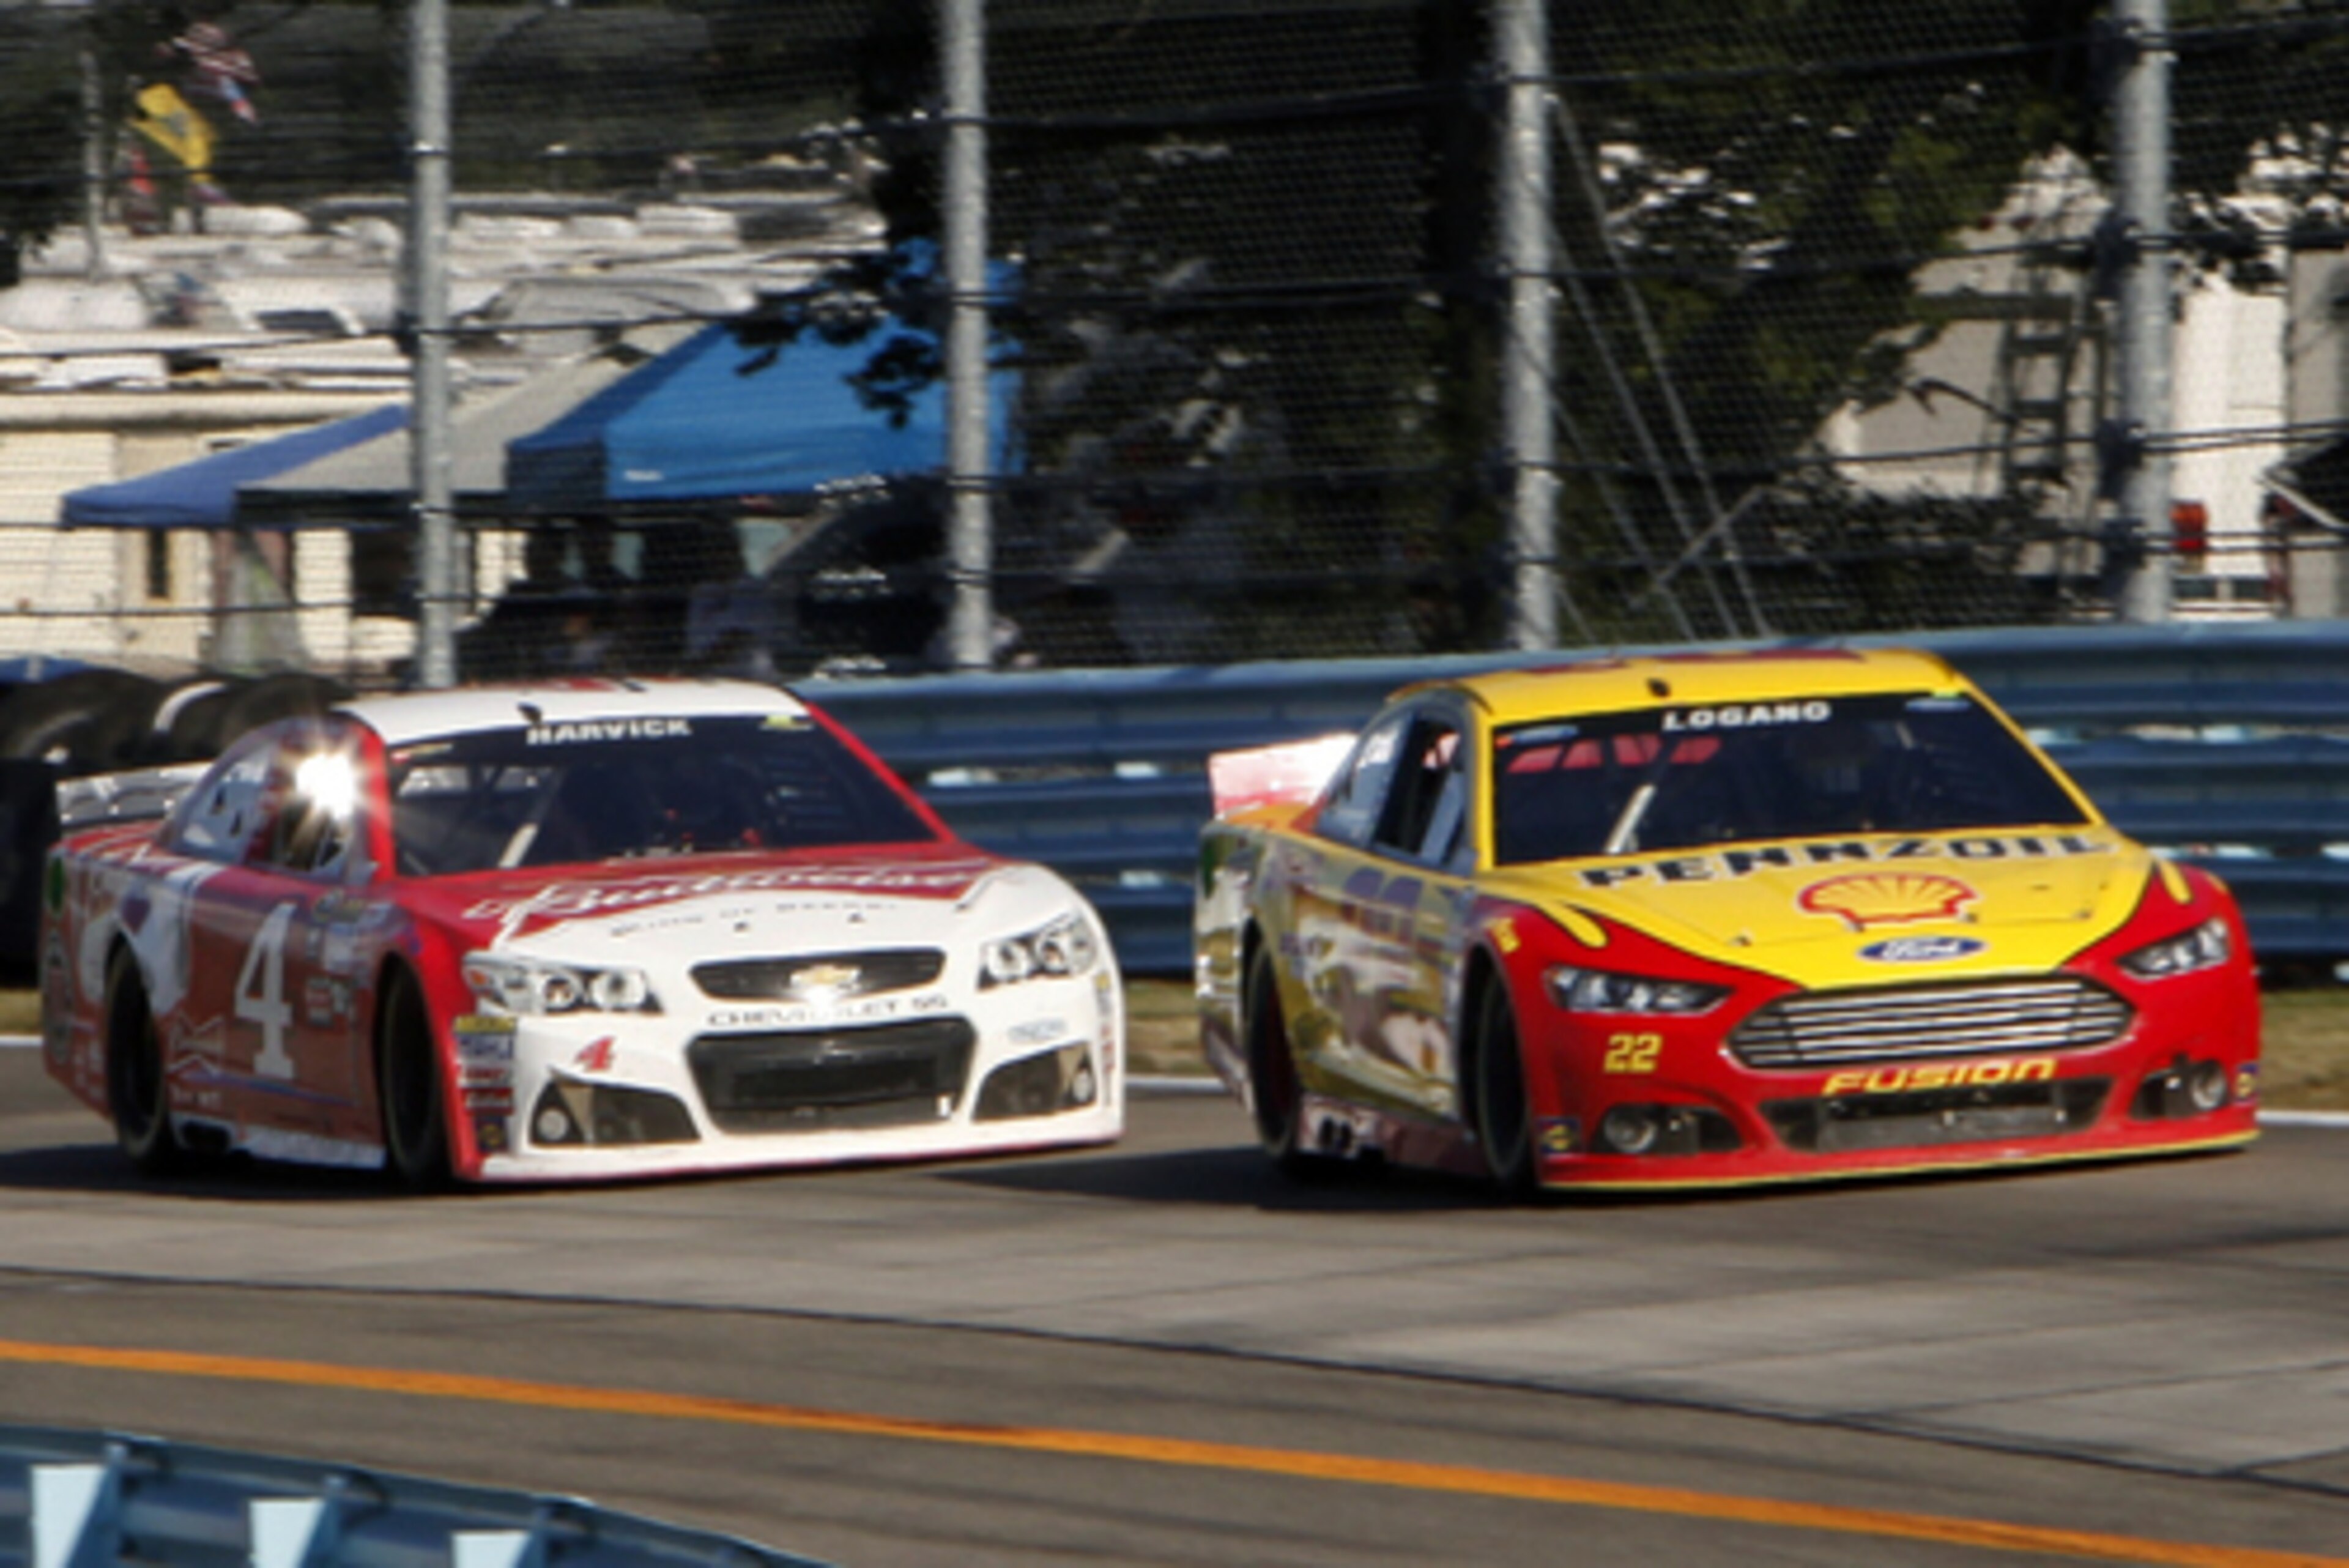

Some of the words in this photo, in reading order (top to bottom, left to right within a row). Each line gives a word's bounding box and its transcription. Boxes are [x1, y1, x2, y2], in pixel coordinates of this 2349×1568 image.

[525, 719, 692, 745] HARVICK
[1662, 701, 1831, 731] LOGANO
[1579, 836, 2115, 888] PENNZOIL
[1882, 938, 1960, 961] Ford
[236, 902, 294, 1079] 4
[572, 1035, 615, 1071] 4
[1604, 1033, 1662, 1074] 22
[1822, 1058, 2057, 1095] FUSION
